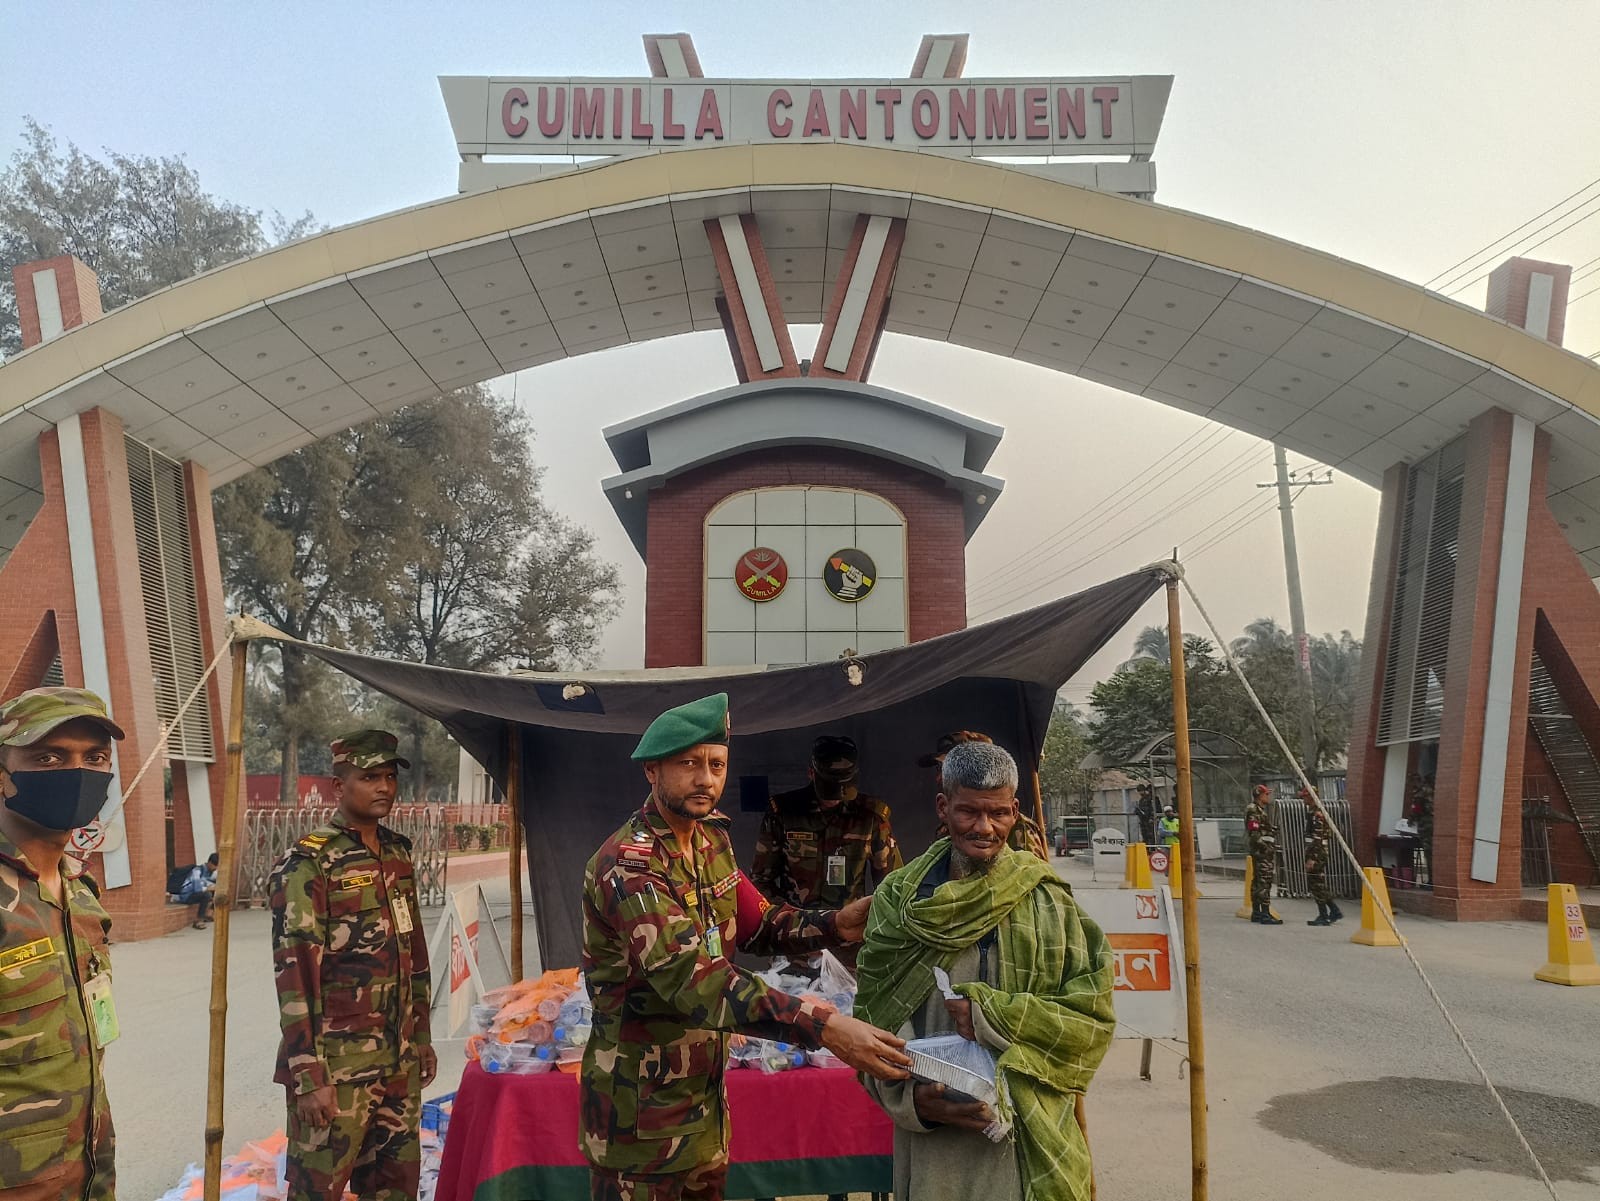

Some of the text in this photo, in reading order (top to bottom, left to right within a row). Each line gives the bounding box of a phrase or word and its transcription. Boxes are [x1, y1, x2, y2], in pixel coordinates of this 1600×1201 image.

[502, 87, 1119, 139] CUMILLA CANTONMENT
[747, 586, 776, 596] CUMILLA
[1567, 905, 1579, 917] 33
[1569, 926, 1584, 939] MP
